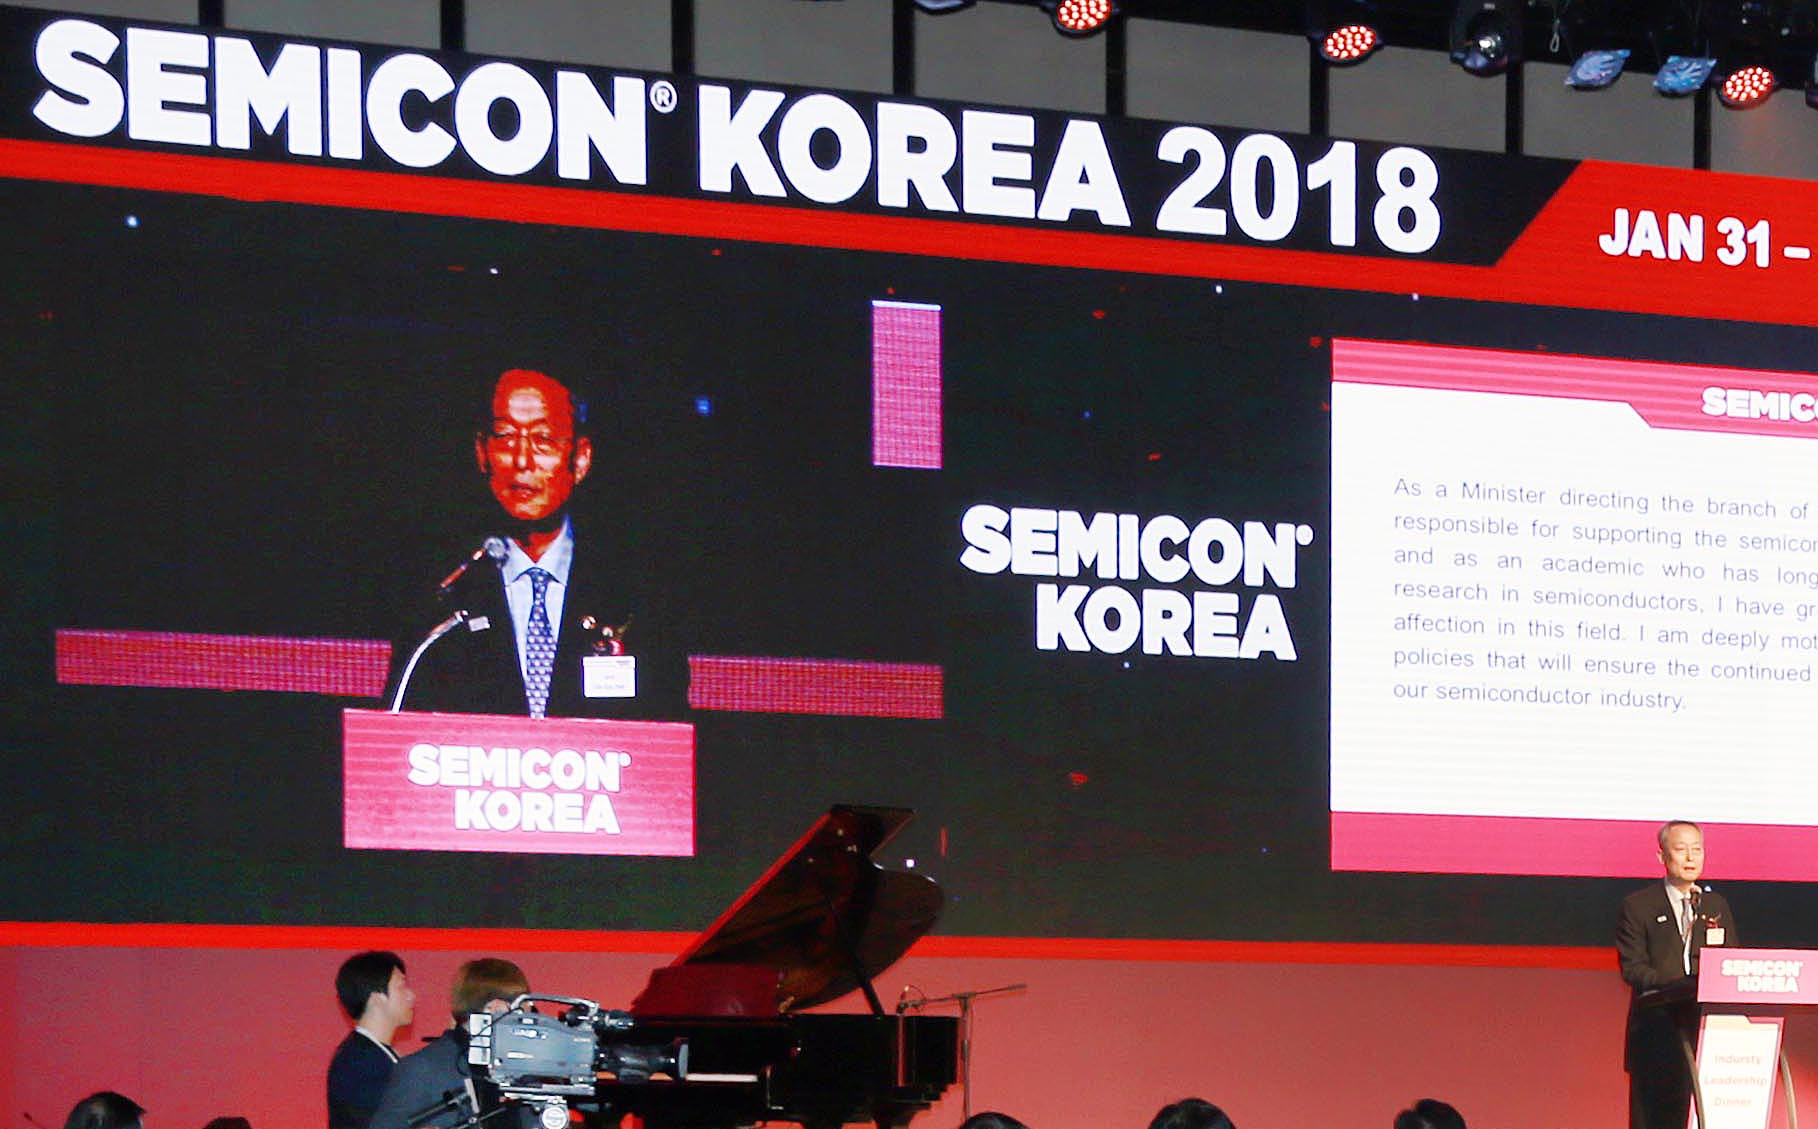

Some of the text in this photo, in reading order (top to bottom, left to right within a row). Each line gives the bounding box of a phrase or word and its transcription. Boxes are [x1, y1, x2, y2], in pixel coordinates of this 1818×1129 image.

[699, 85, 1131, 226] KOREA
[1157, 127, 1440, 252] 2018
[1599, 209, 1703, 261] JAN
[1717, 218, 1769, 267] 31
[1393, 477, 1422, 497] As
[1434, 483, 1448, 499] a
[1461, 481, 1546, 505] Minister
[1559, 487, 1649, 515] directing
[1661, 495, 1695, 513] the
[1707, 496, 1777, 518] branch
[1789, 502, 1809, 520] of
[1394, 515, 1519, 537] responsible
[1531, 519, 1560, 538] for
[1572, 525, 1682, 550] supporting
[1694, 529, 1728, 549] the
[1393, 546, 1434, 565] and
[1453, 552, 1478, 568] as
[1497, 554, 1523, 569] an
[1541, 555, 1644, 577] academic
[1661, 560, 1705, 580] who
[1722, 562, 1760, 583] has
[1393, 583, 1488, 601] research
[1501, 583, 1520, 603] in
[1735, 596, 1785, 616] have
[1037, 583, 1297, 660] KOREA
[1393, 612, 1485, 635] affection
[1497, 617, 1516, 636] in
[1527, 619, 1565, 639] this
[1657, 629, 1689, 644] am
[1701, 628, 1770, 653] deeply
[1393, 647, 1475, 669] policies
[1487, 650, 1527, 670] that
[1537, 653, 1572, 672] will
[1584, 658, 1657, 676] ensure
[1667, 658, 1701, 678] the
[1710, 663, 1811, 682] continued
[1393, 683, 1429, 699] our
[1435, 683, 1593, 705] semiconductor
[454, 789, 621, 834] KOREA
[1737, 975, 1799, 993] KOREA
